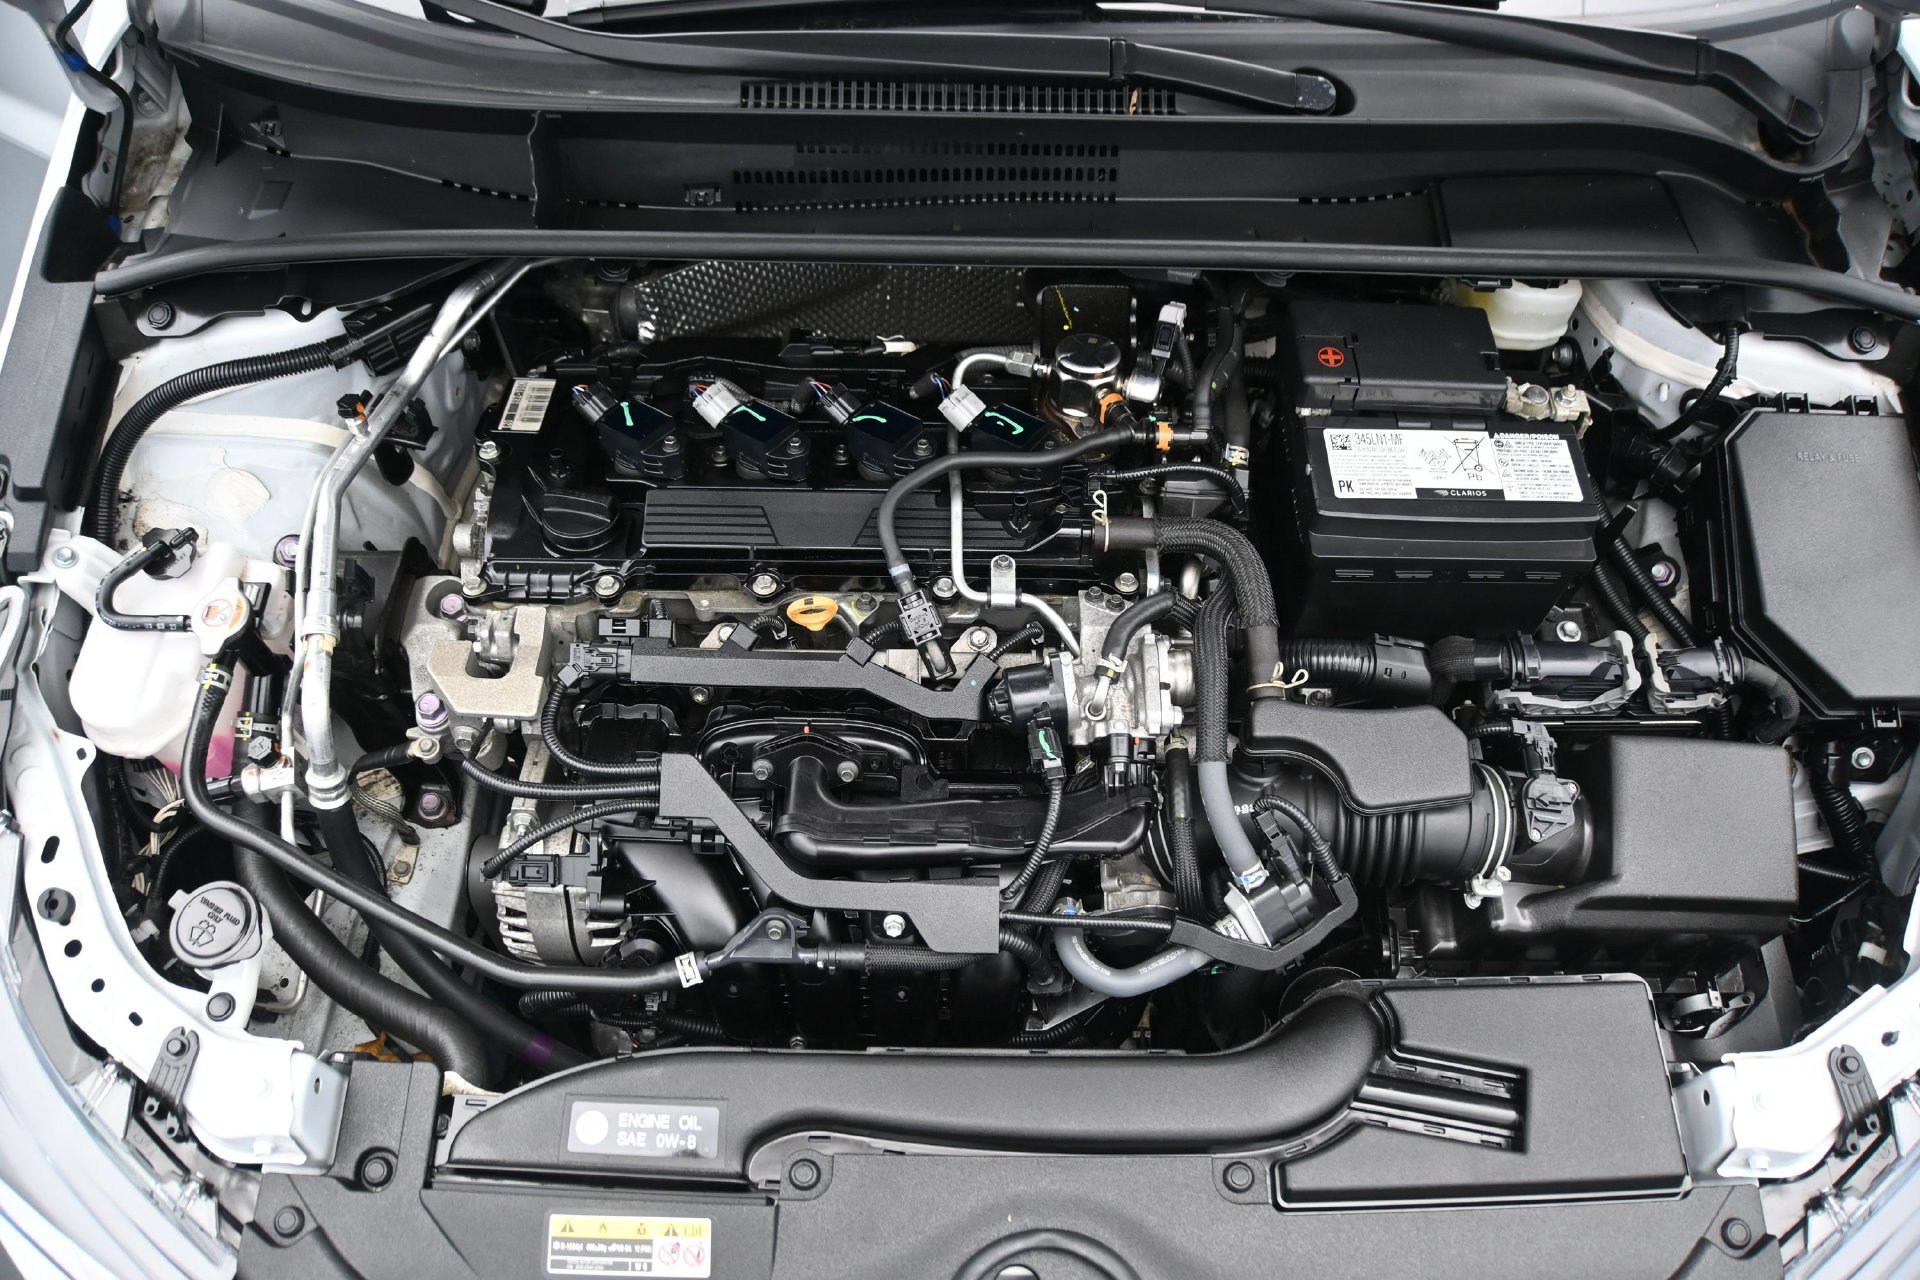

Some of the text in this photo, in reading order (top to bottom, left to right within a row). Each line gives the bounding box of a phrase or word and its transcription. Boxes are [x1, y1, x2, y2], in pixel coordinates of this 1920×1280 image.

[1355, 433, 1403, 446] 345LN1-MF
[1797, 452, 1825, 462] RELAY
[1837, 452, 1861, 463] FUSE
[1468, 472, 1483, 482] Pb
[1338, 479, 1355, 493] PK
[1450, 489, 1488, 497] CLARIOS
[207, 911, 224, 924] ONLY
[223, 912, 241, 926] FLUID
[618, 1112, 702, 1131] ENGINE OIL
[616, 1131, 647, 1147] SAE
